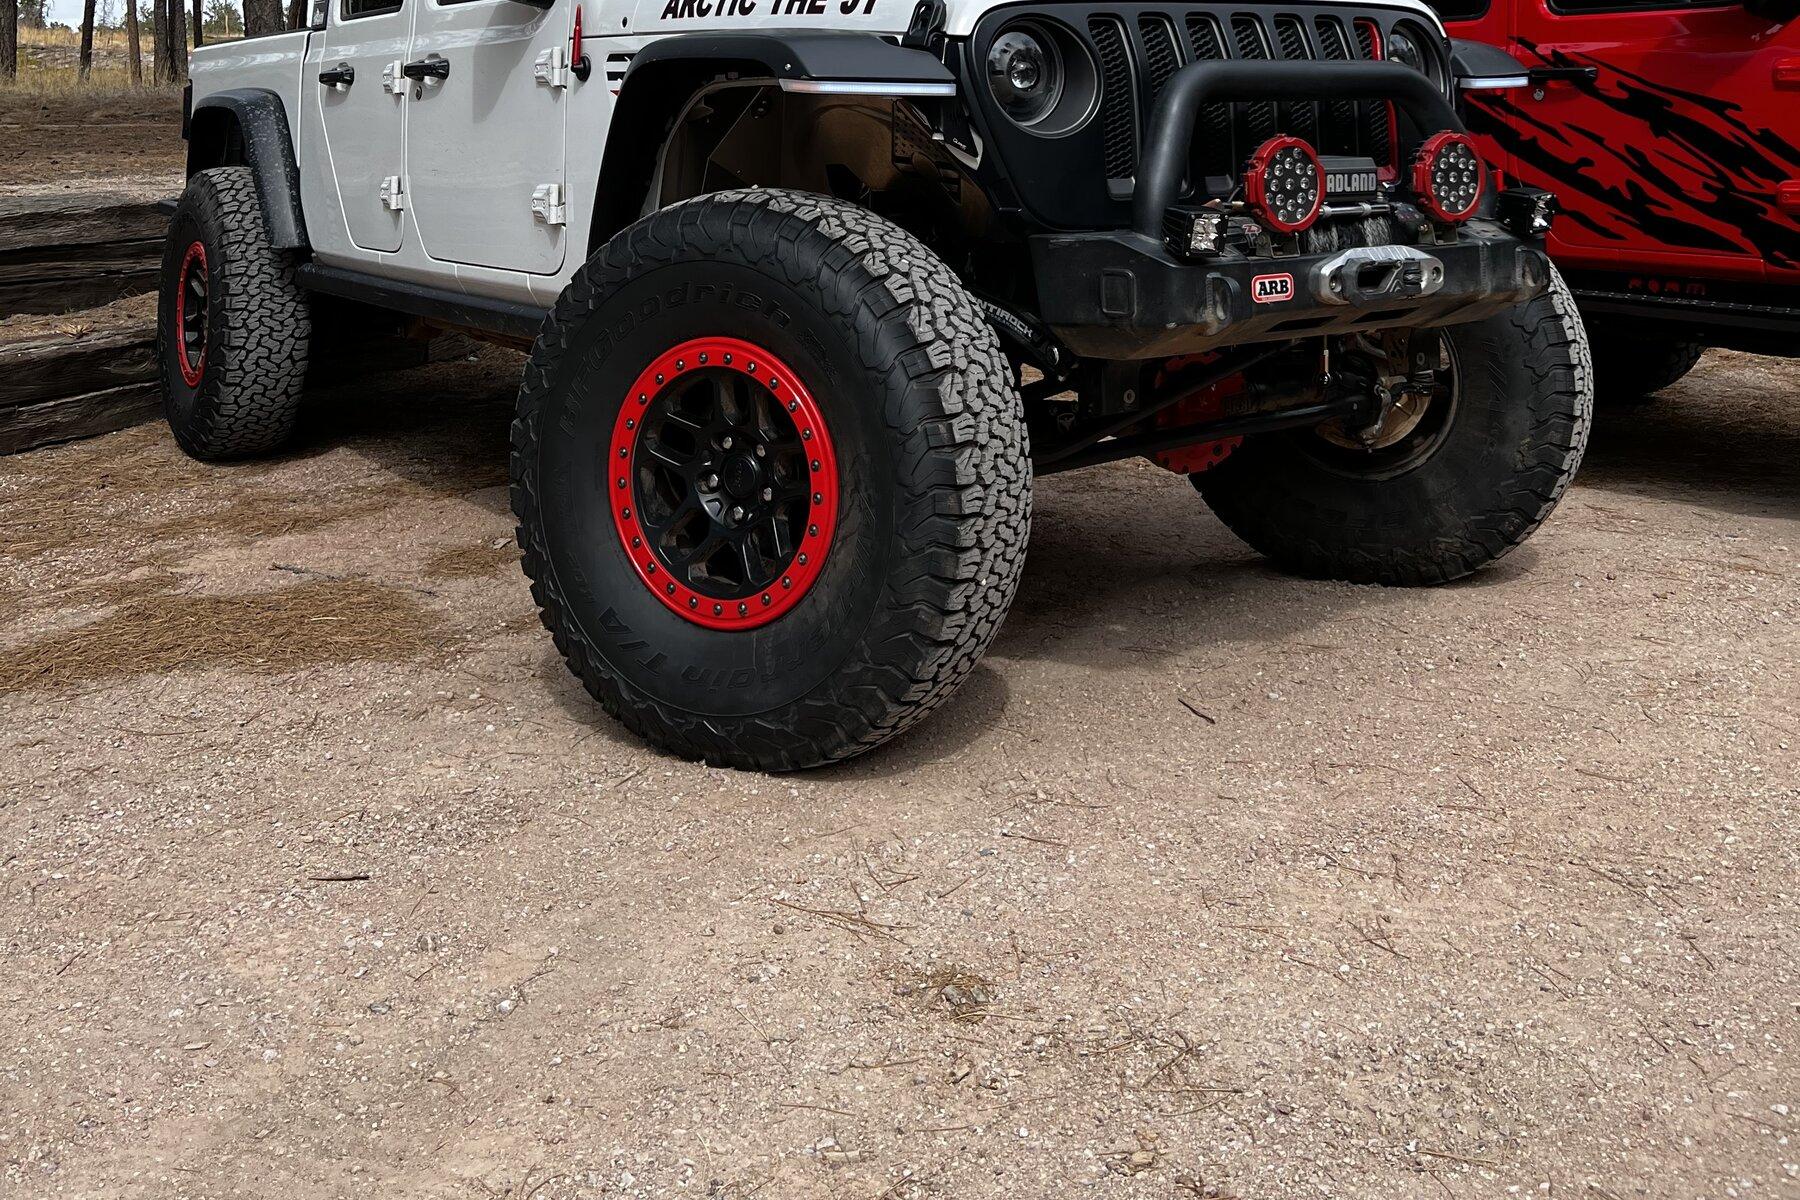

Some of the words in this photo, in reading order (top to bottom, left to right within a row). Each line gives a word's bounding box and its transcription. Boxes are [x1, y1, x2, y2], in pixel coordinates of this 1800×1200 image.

[1326, 172, 1377, 192] ADLAND
[1257, 279, 1290, 296] ARB
[975, 297, 1034, 338] NTIROCK
